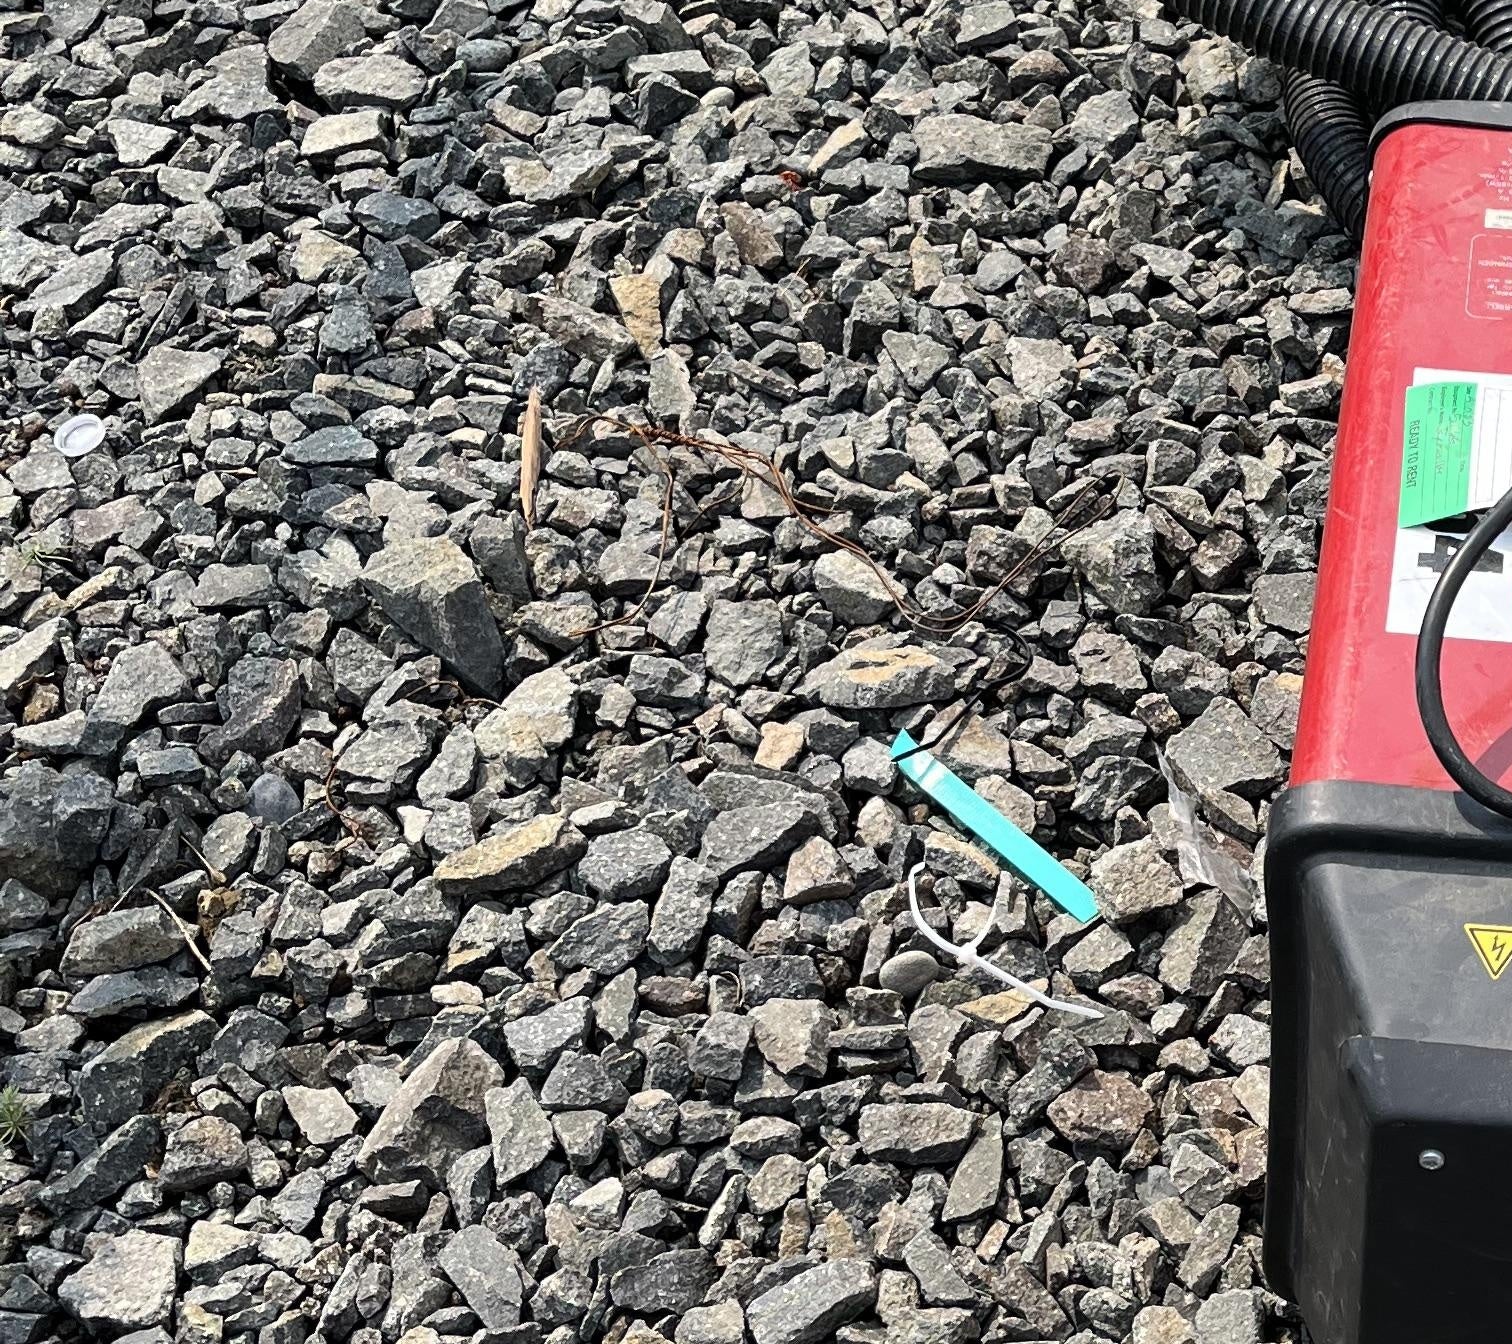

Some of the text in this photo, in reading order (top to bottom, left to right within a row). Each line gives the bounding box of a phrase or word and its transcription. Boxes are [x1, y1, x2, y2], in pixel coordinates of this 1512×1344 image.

[1405, 420, 1420, 489] READY TO RENT
